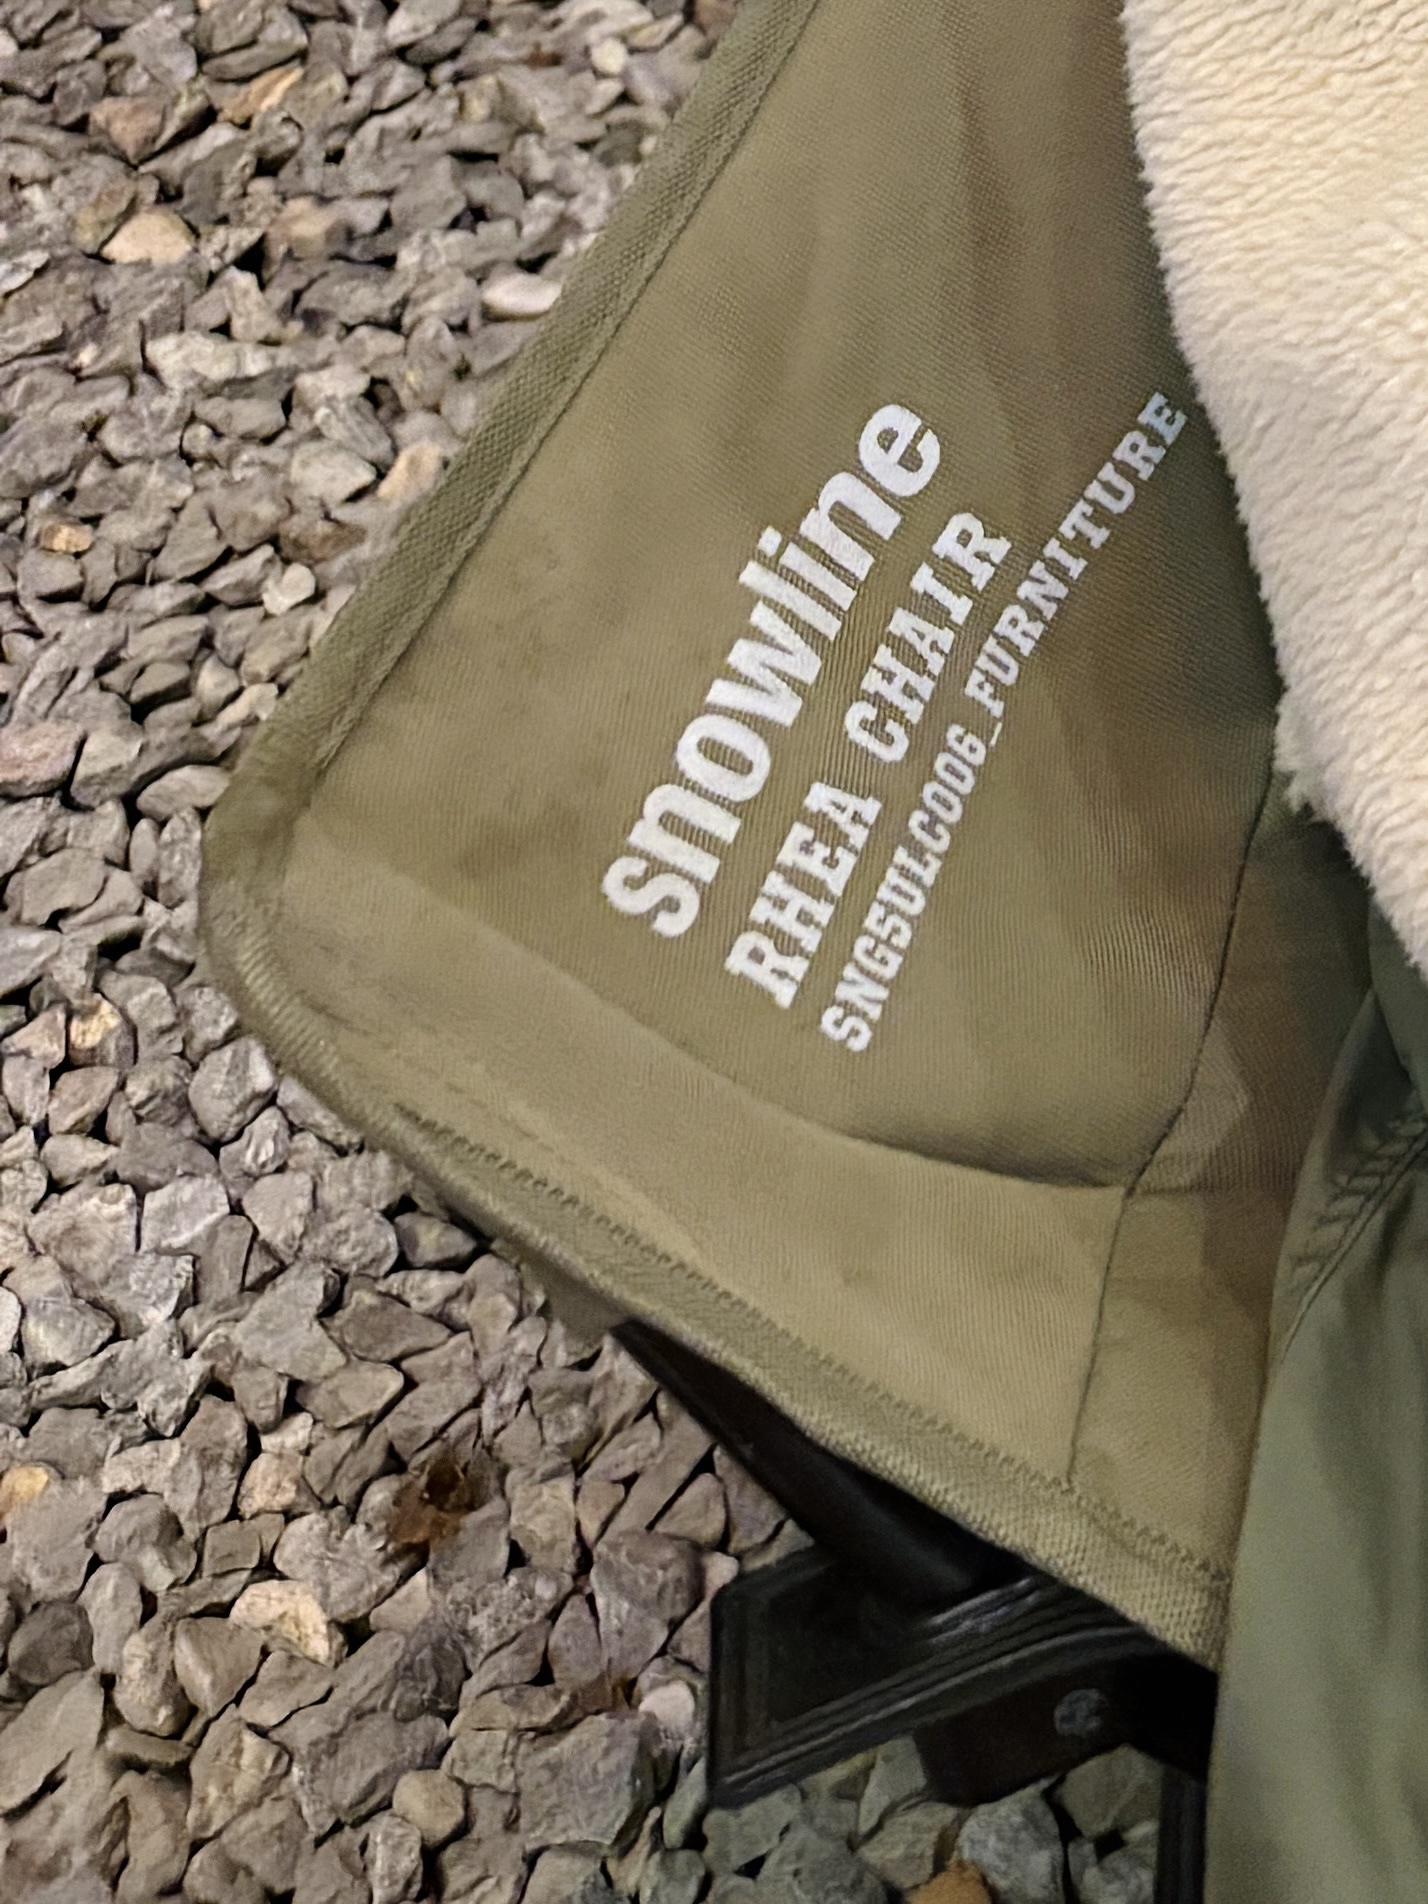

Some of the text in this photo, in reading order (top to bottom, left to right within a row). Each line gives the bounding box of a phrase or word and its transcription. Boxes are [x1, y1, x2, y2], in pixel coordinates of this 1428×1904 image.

[601, 402, 941, 938] snowline
[724, 511, 1013, 1010] RHEA CHAIR
